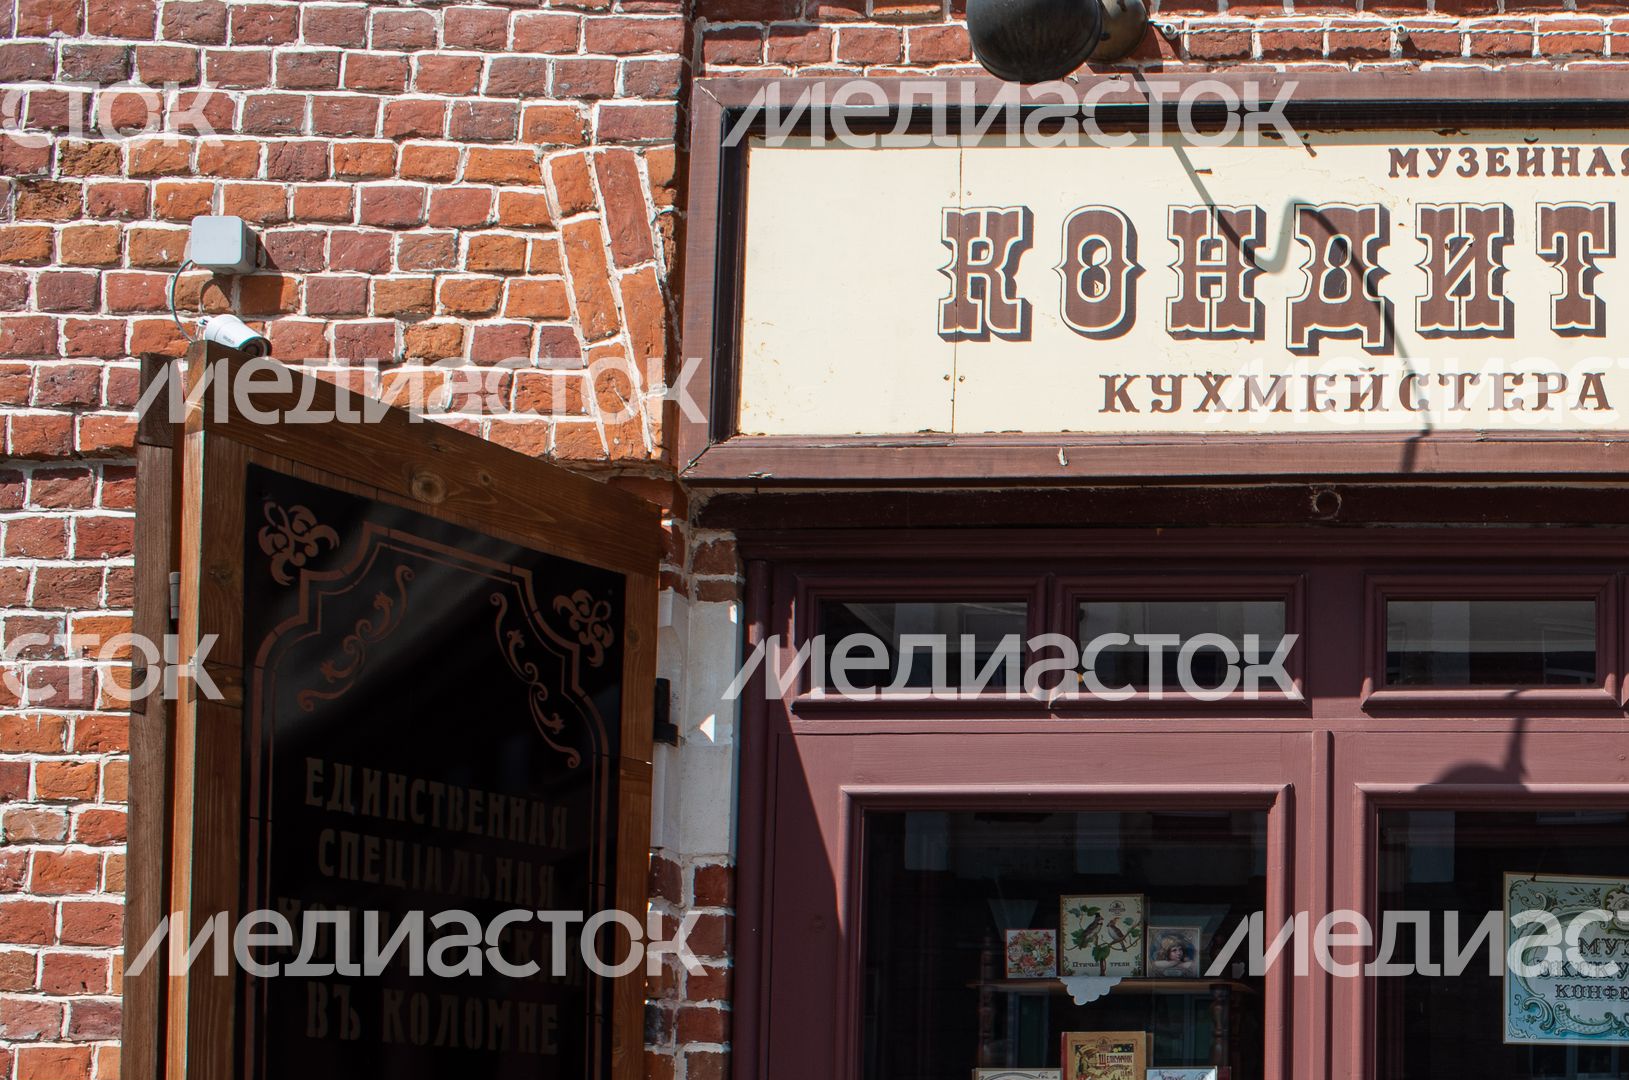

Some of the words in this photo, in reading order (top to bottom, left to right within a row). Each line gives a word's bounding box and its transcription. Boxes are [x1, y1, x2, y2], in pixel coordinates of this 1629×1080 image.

[1098, 367, 1614, 413] КУХМЕЙСТЕРА
[304, 756, 570, 850] ЕДИНСТВЕННАЯ
[305, 980, 362, 1040] ВЪ
[382, 986, 561, 1056] КОЛОМНЕ
